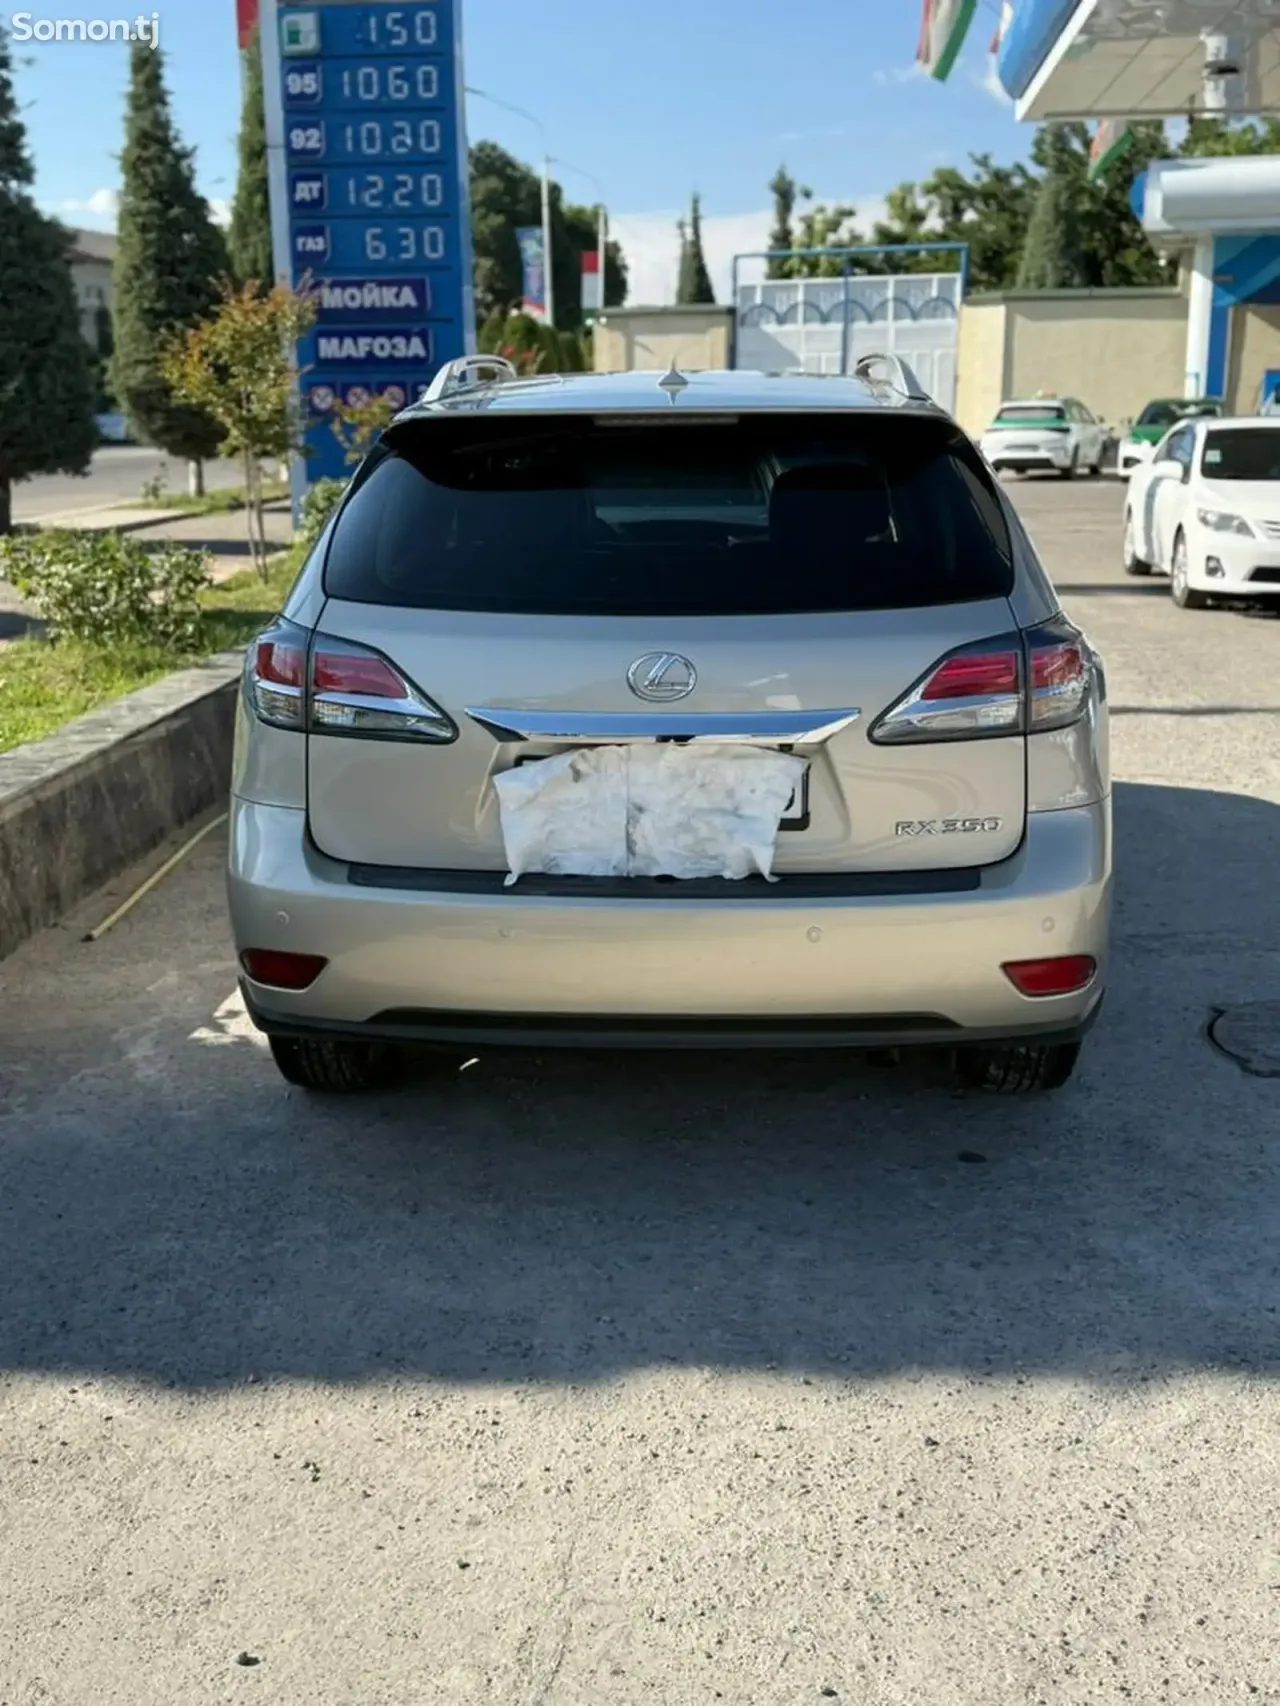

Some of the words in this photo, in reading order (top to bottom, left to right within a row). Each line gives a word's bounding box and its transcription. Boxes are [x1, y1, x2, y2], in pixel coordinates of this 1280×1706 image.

[286, 72, 318, 95] 95
[290, 127, 322, 150] 92
[294, 181, 322, 202] ДТ
[296, 235, 325, 252] ГАЗ
[323, 282, 418, 309] МОЙКА
[895, 819, 938, 836] RX
[941, 817, 1004, 834] 350
